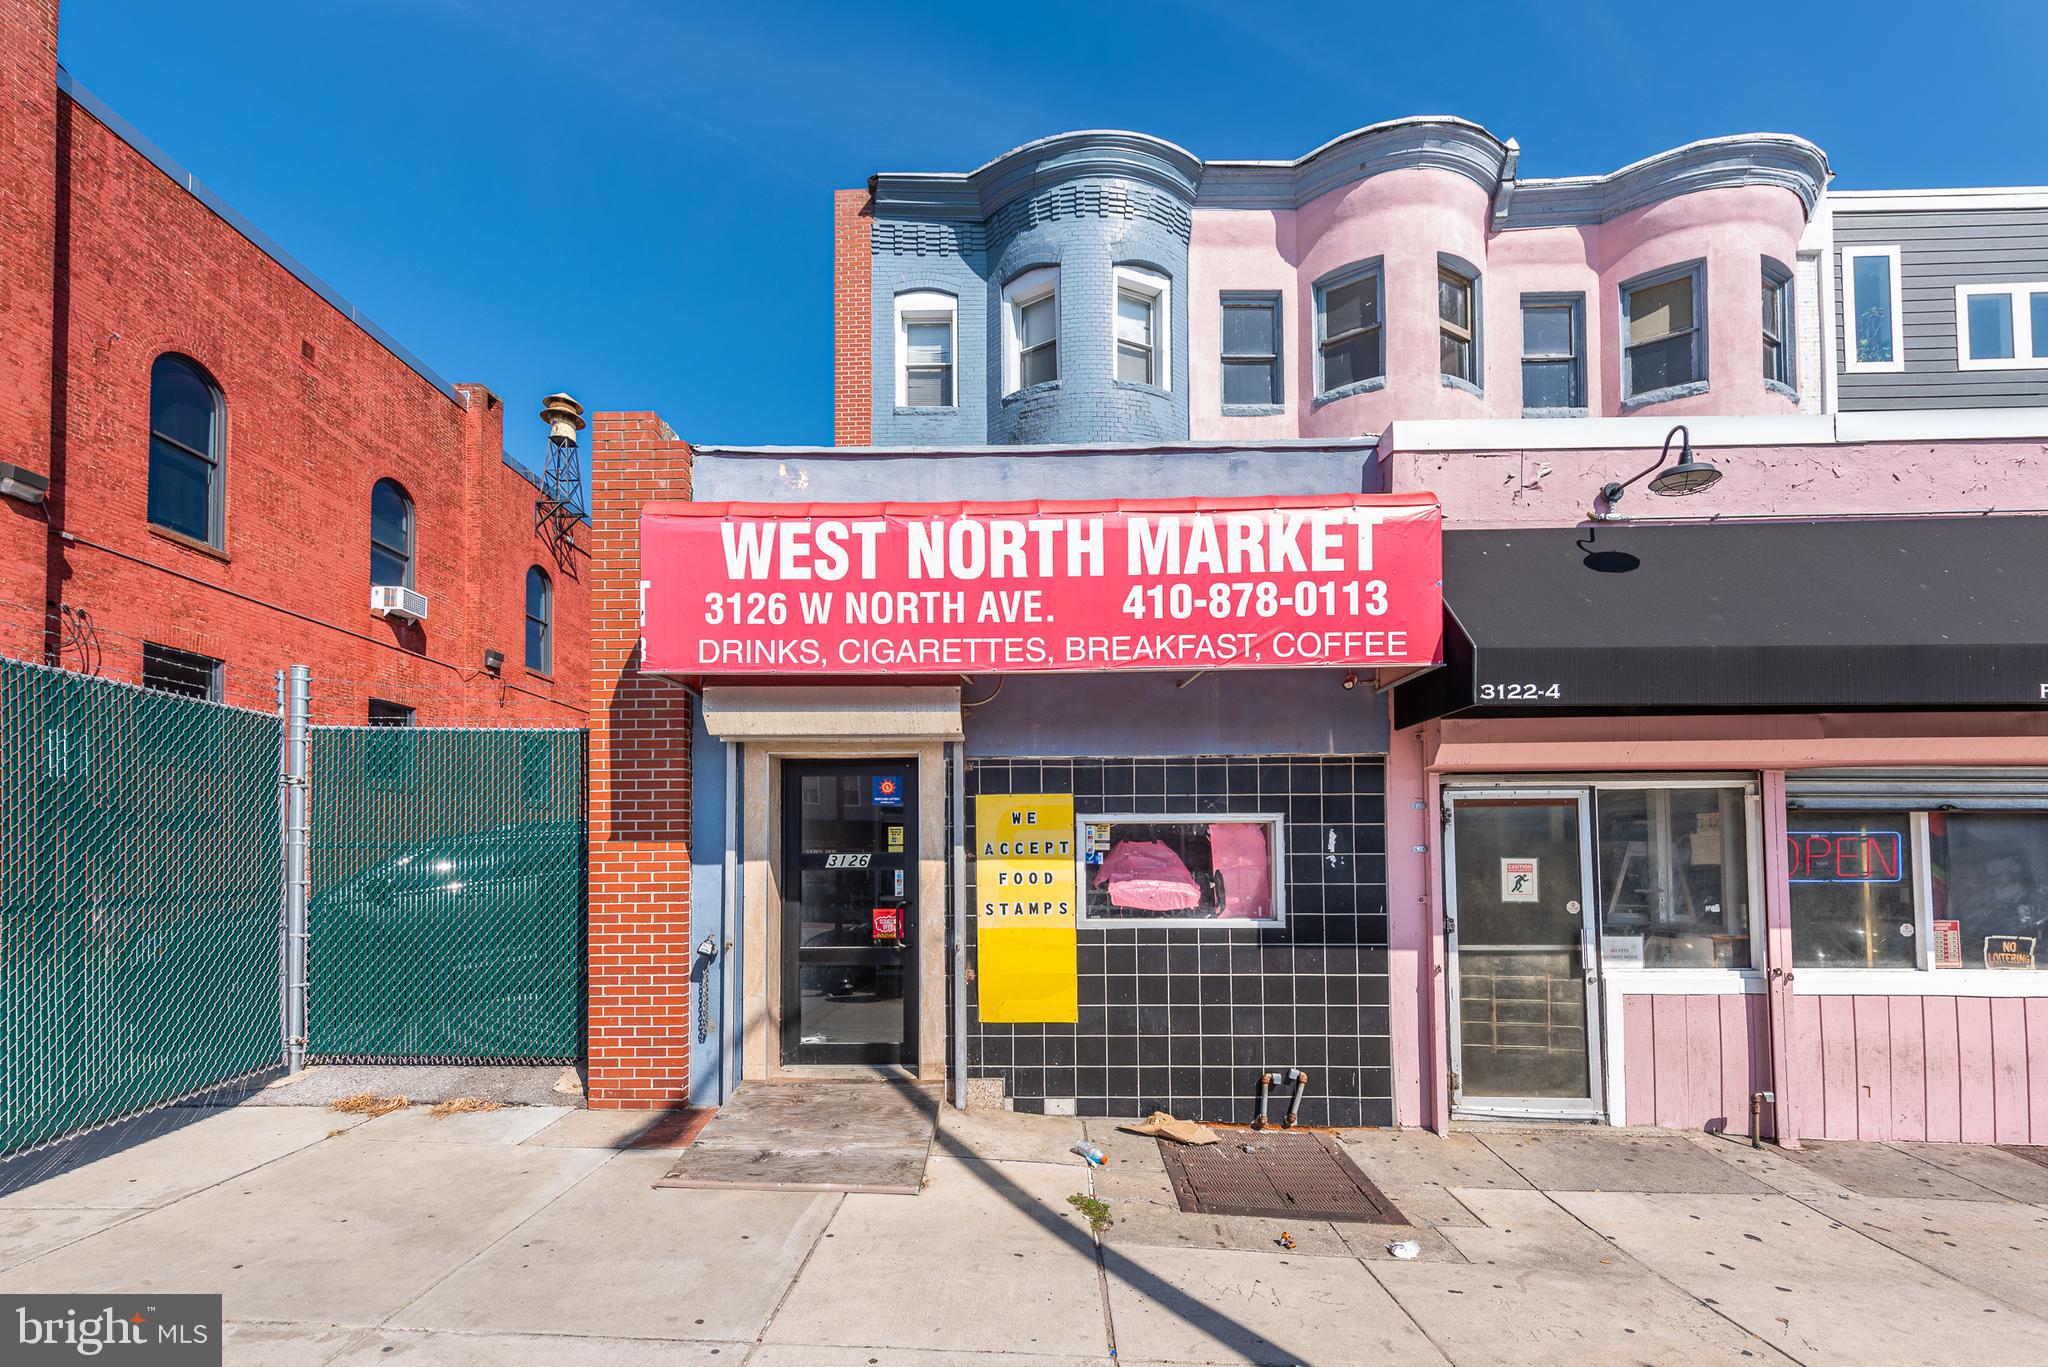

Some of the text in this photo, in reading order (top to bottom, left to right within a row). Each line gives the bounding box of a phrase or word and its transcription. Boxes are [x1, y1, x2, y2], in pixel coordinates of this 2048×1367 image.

[720, 513, 1384, 581] WEST NORTH MARKET
[704, 579, 1389, 625] 3126 W NORTH AVE. 410-878-0113
[699, 631, 1408, 667] DRINKS, CIGARETTES, BREAKFAST, COFFEE
[1480, 683, 1561, 700] 3122-4
[1012, 812, 1036, 824] WE
[984, 841, 1068, 855] ACCEPT
[827, 855, 869, 867] 3126
[999, 872, 1053, 884] FOOD
[985, 902, 1068, 915] STAMPS
[2002, 941, 2017, 953] NO
[1987, 952, 2032, 964] LOITERING
